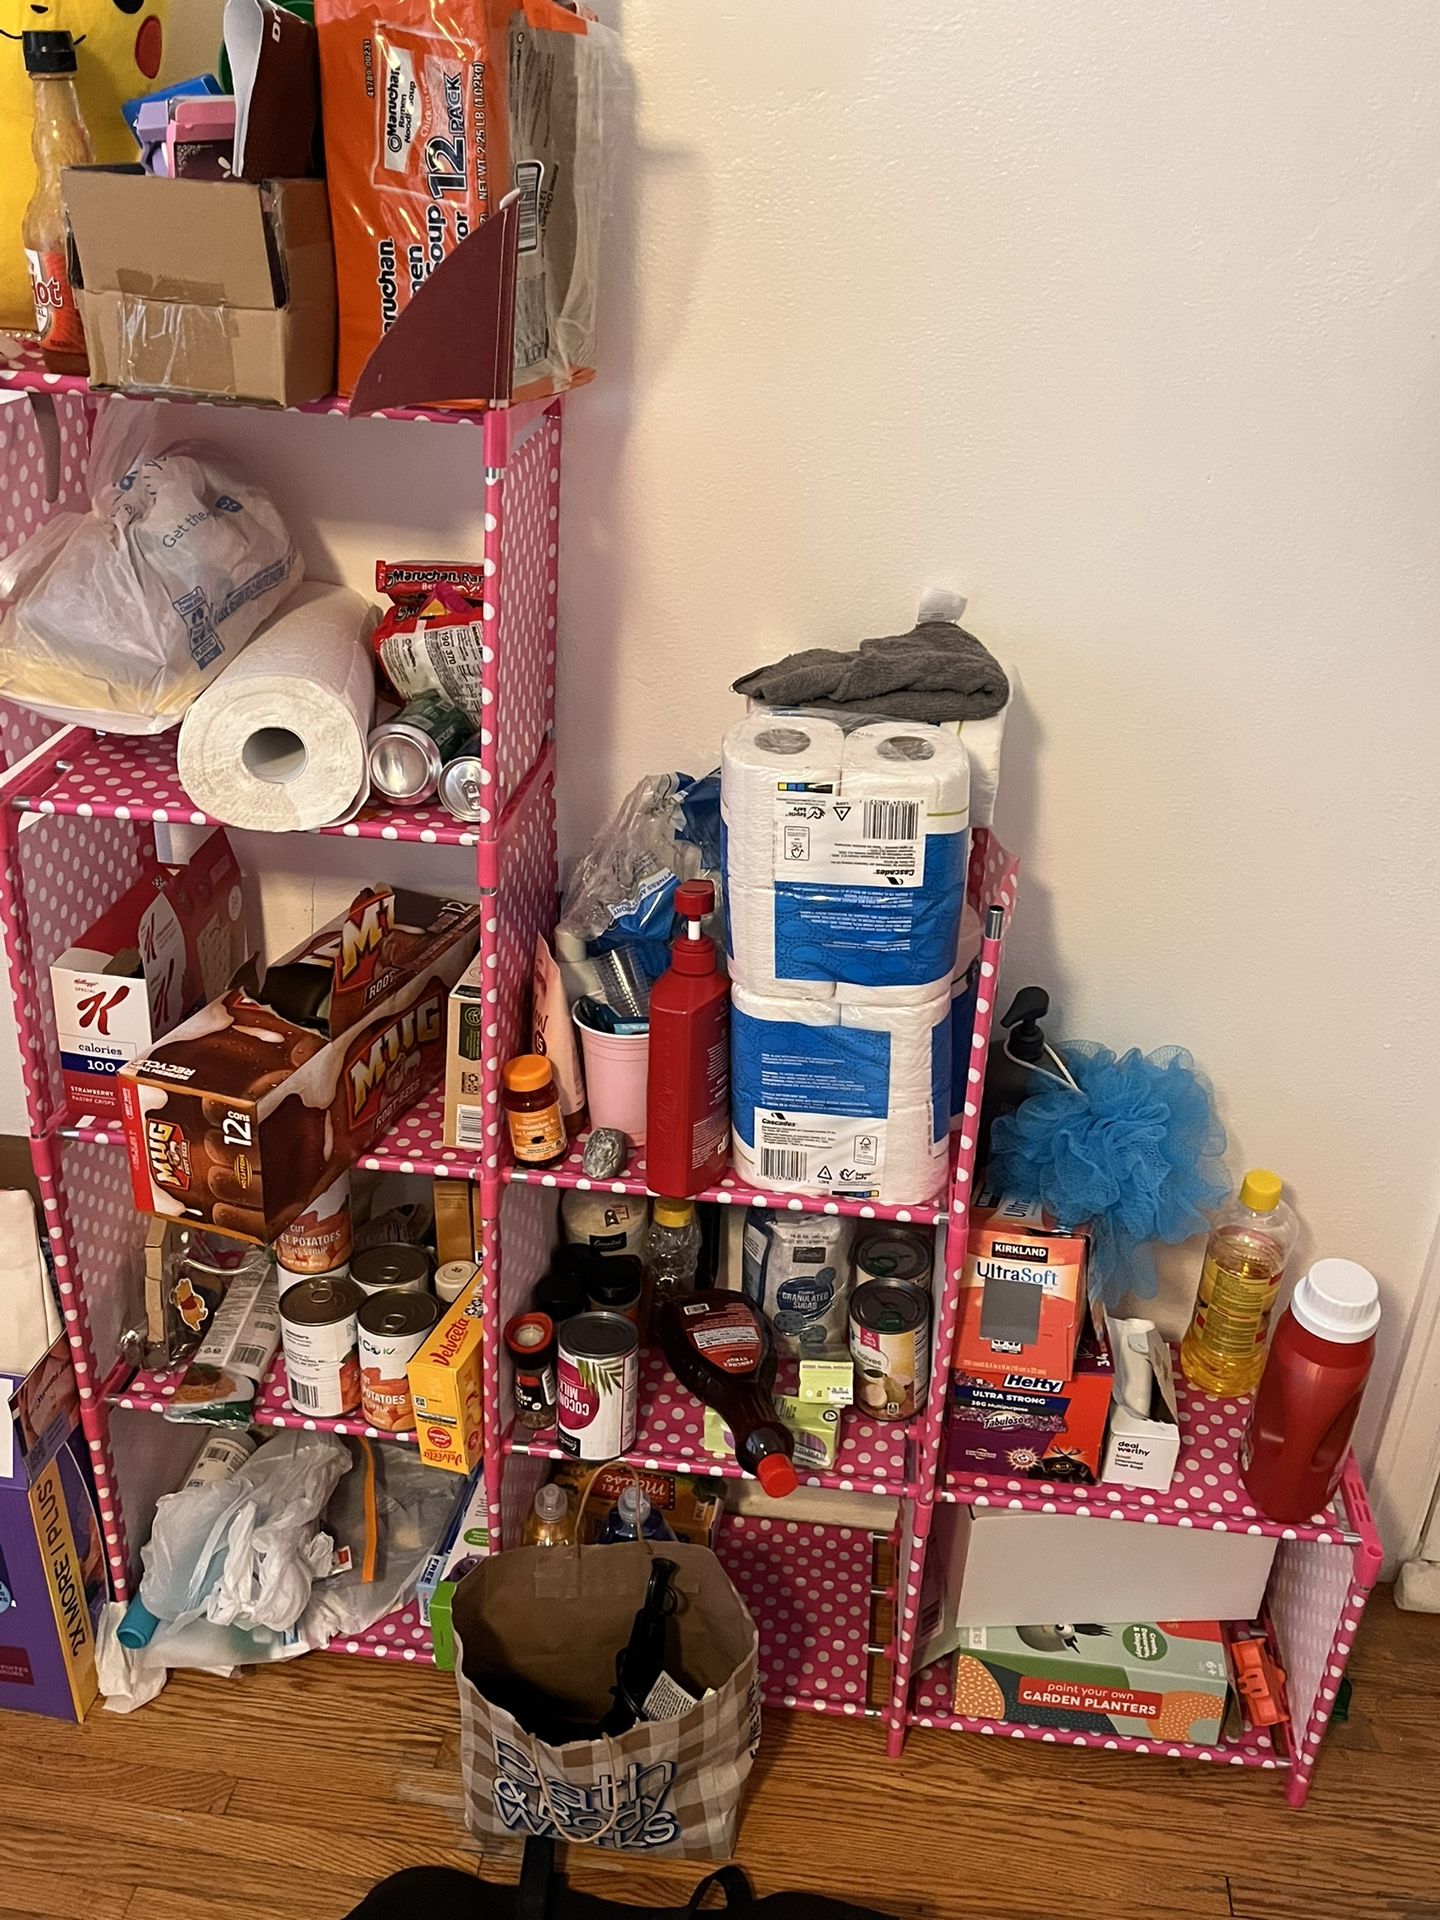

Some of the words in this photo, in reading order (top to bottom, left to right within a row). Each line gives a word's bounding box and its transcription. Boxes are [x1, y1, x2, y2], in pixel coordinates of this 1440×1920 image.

[443, 72, 466, 134] PACK
[475, 110, 486, 126] LB
[425, 135, 468, 200] 12
[478, 179, 488, 200] NET
[378, 238, 397, 334] aruchan
[163, 522, 188, 548] Get
[875, 868, 915, 877] Cascades
[77, 985, 131, 1035] K
[79, 1043, 123, 1056] calories
[349, 996, 441, 1119] MUG
[87, 1059, 116, 1073] 100
[70, 1086, 114, 1097] STRAWBERRY
[72, 1095, 94, 1103] PASTRY
[227, 1110, 251, 1123] cans
[762, 1117, 797, 1128] Cascades
[222, 1118, 252, 1147] 12
[148, 1122, 182, 1187] MUG
[290, 1224, 305, 1233] CUT
[293, 1230, 341, 1247] POTATOES
[994, 1243, 1047, 1258] KIRKLAND
[782, 1291, 829, 1301] GRANULATED
[792, 1301, 818, 1310] SUGAR
[429, 1317, 470, 1366] Velveeta
[1007, 1374, 1062, 1393] Hefty
[972, 1390, 1004, 1400] ULTRA
[1006, 1395, 1046, 1405] STRONG
[983, 1414, 1024, 1429] Fabuloso
[1117, 1446, 1151, 1456] worthy
[1118, 1441, 1140, 1449] deal
[423, 1451, 463, 1467] Velveeta
[424, 1557, 440, 1585] FREE
[70, 1619, 87, 1657] 2X
[1047, 1683, 1079, 1694] paint
[1081, 1687, 1109, 1698] your
[1111, 1690, 1135, 1701] own
[1022, 1690, 1081, 1708] GARDEN
[1084, 1697, 1157, 1715] PLANTERS
[492, 1735, 676, 1812] Bath
[493, 1776, 529, 1811] &
